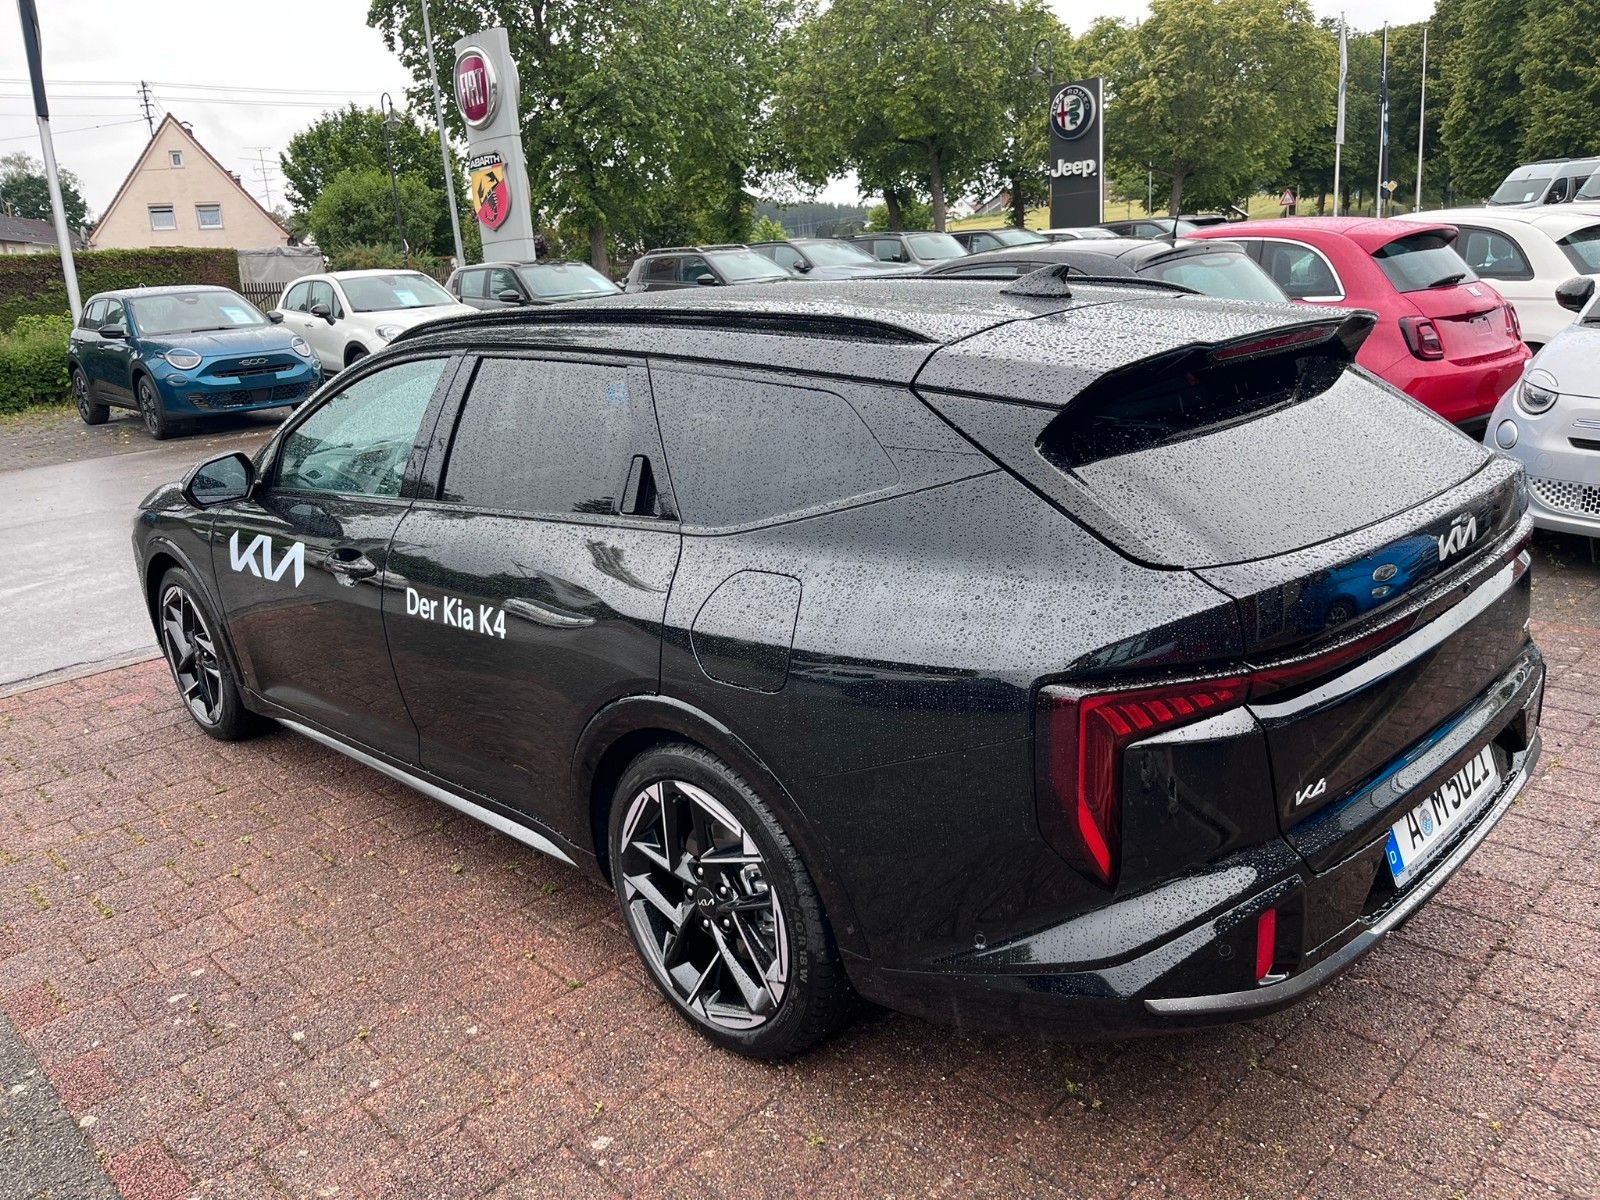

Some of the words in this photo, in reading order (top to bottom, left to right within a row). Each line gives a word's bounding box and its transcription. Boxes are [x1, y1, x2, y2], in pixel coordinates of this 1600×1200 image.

[459, 68, 485, 109] FIAT
[1052, 93, 1065, 116] ALFA
[1067, 88, 1090, 111] ROMEO
[470, 155, 500, 169] ABARTH
[1050, 158, 1097, 178] Jeep
[1438, 516, 1477, 562] KIA
[229, 529, 305, 588] KIA
[406, 587, 437, 621] Der
[443, 596, 474, 631] Kia
[480, 604, 507, 640] K4
[1295, 777, 1327, 806] K4
[1405, 810, 1425, 850] A
[1429, 785, 1450, 827] M
[1389, 850, 1397, 865] D
